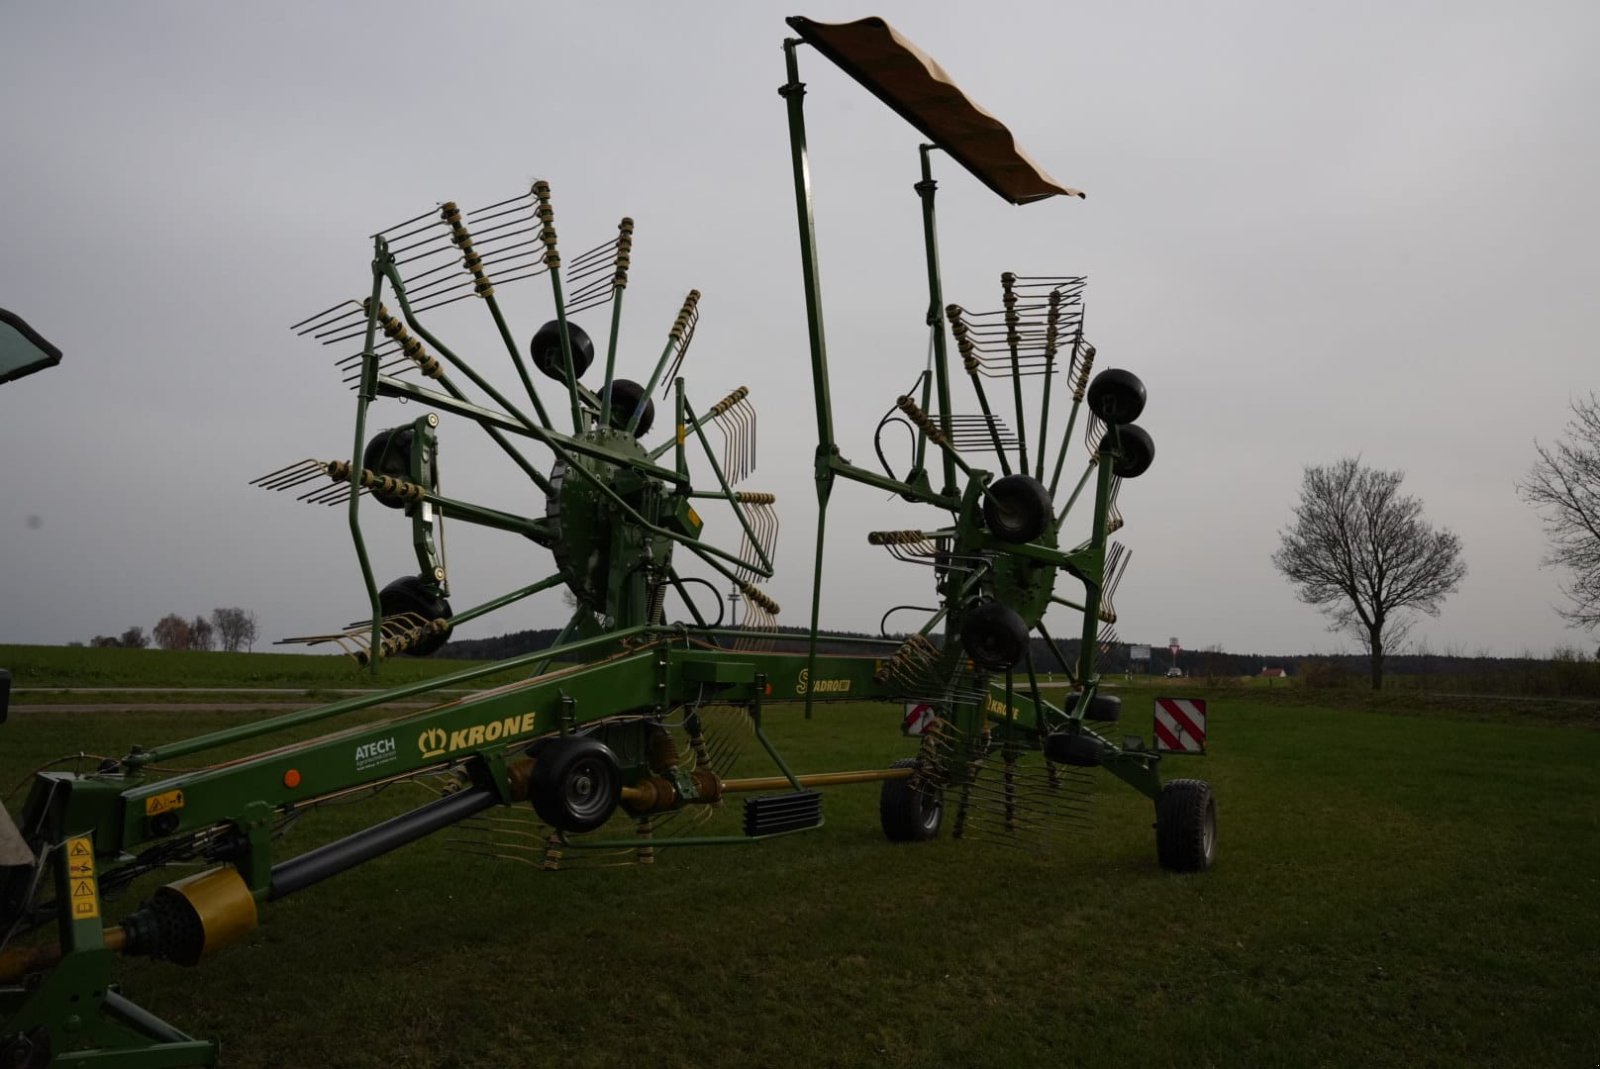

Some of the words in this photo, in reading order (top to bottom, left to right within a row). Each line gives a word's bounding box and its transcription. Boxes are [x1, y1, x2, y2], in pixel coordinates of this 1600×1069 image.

[796, 668, 839, 694] SADRO
[449, 712, 536, 752] KRONE
[355, 737, 396, 760] ATECH
